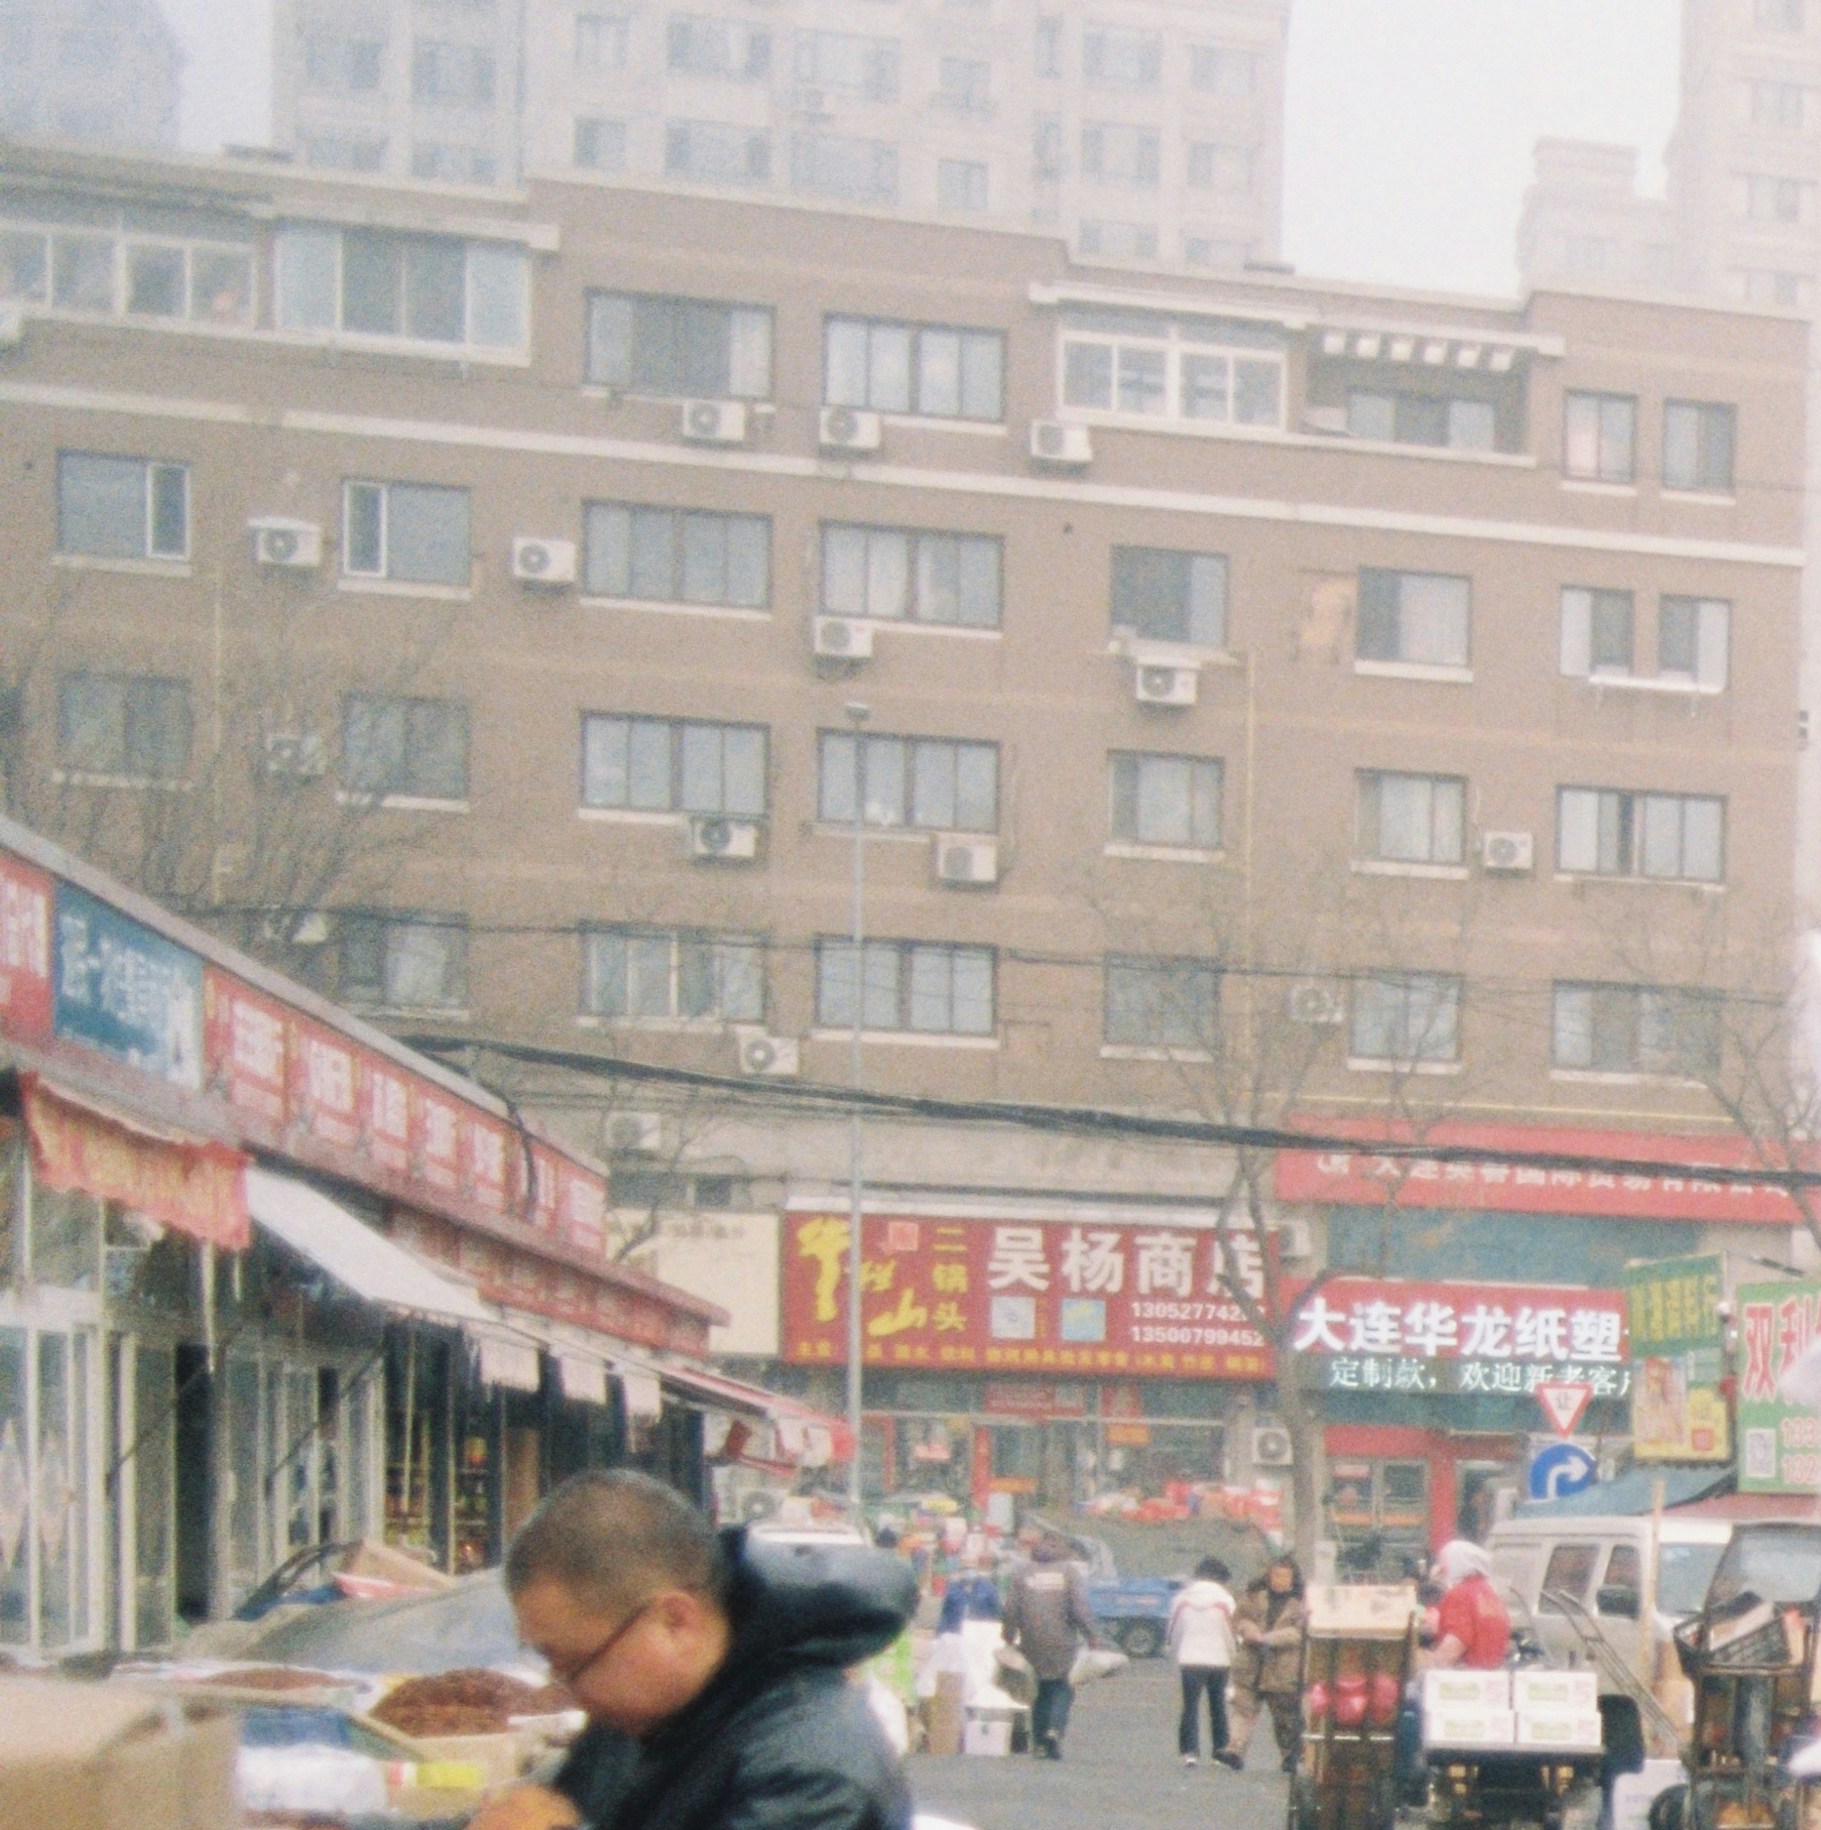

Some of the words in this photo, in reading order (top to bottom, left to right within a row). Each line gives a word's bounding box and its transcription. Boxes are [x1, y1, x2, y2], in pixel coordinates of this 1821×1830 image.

[988, 1226, 1265, 1299] 吴杨商店
[1294, 1297, 1629, 1362] 大连华龙纸塑
